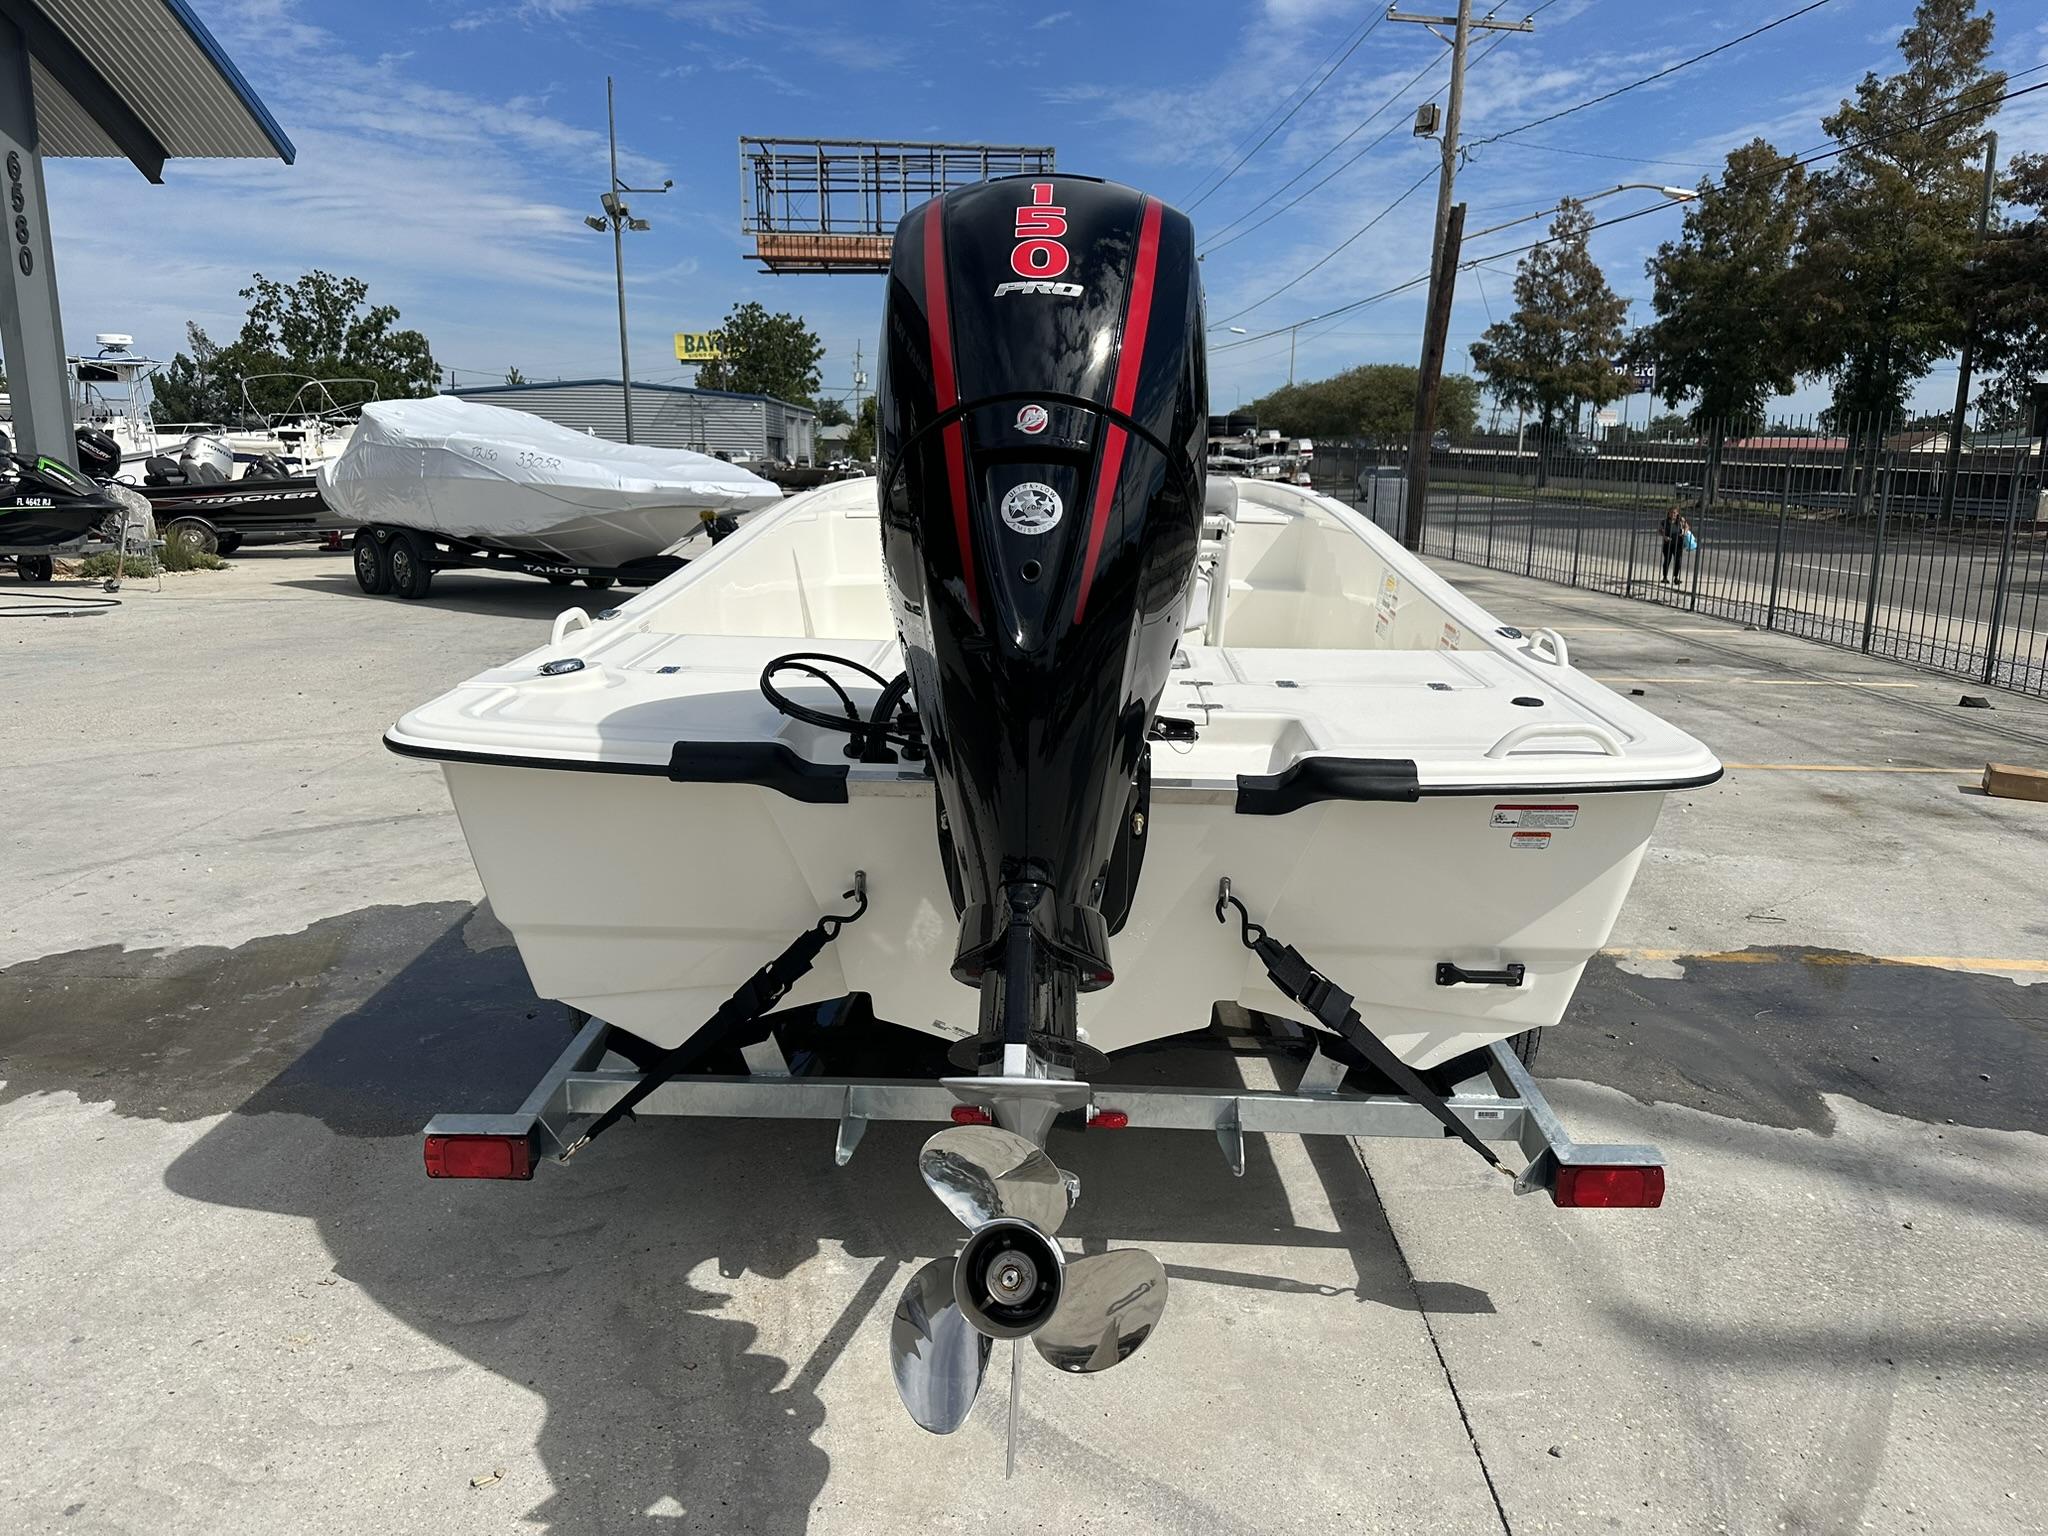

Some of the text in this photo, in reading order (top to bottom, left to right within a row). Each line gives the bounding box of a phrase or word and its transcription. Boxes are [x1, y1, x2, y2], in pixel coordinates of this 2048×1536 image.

[7, 150, 33, 276] 6580
[1010, 183, 1070, 279] 150
[994, 281, 1084, 297] PRO
[192, 491, 319, 505] TRACKER
[1008, 484, 1056, 498] ULTRA LOW
[16, 497, 51, 507] FL 4642 RJ
[523, 564, 590, 575] TAHOE
